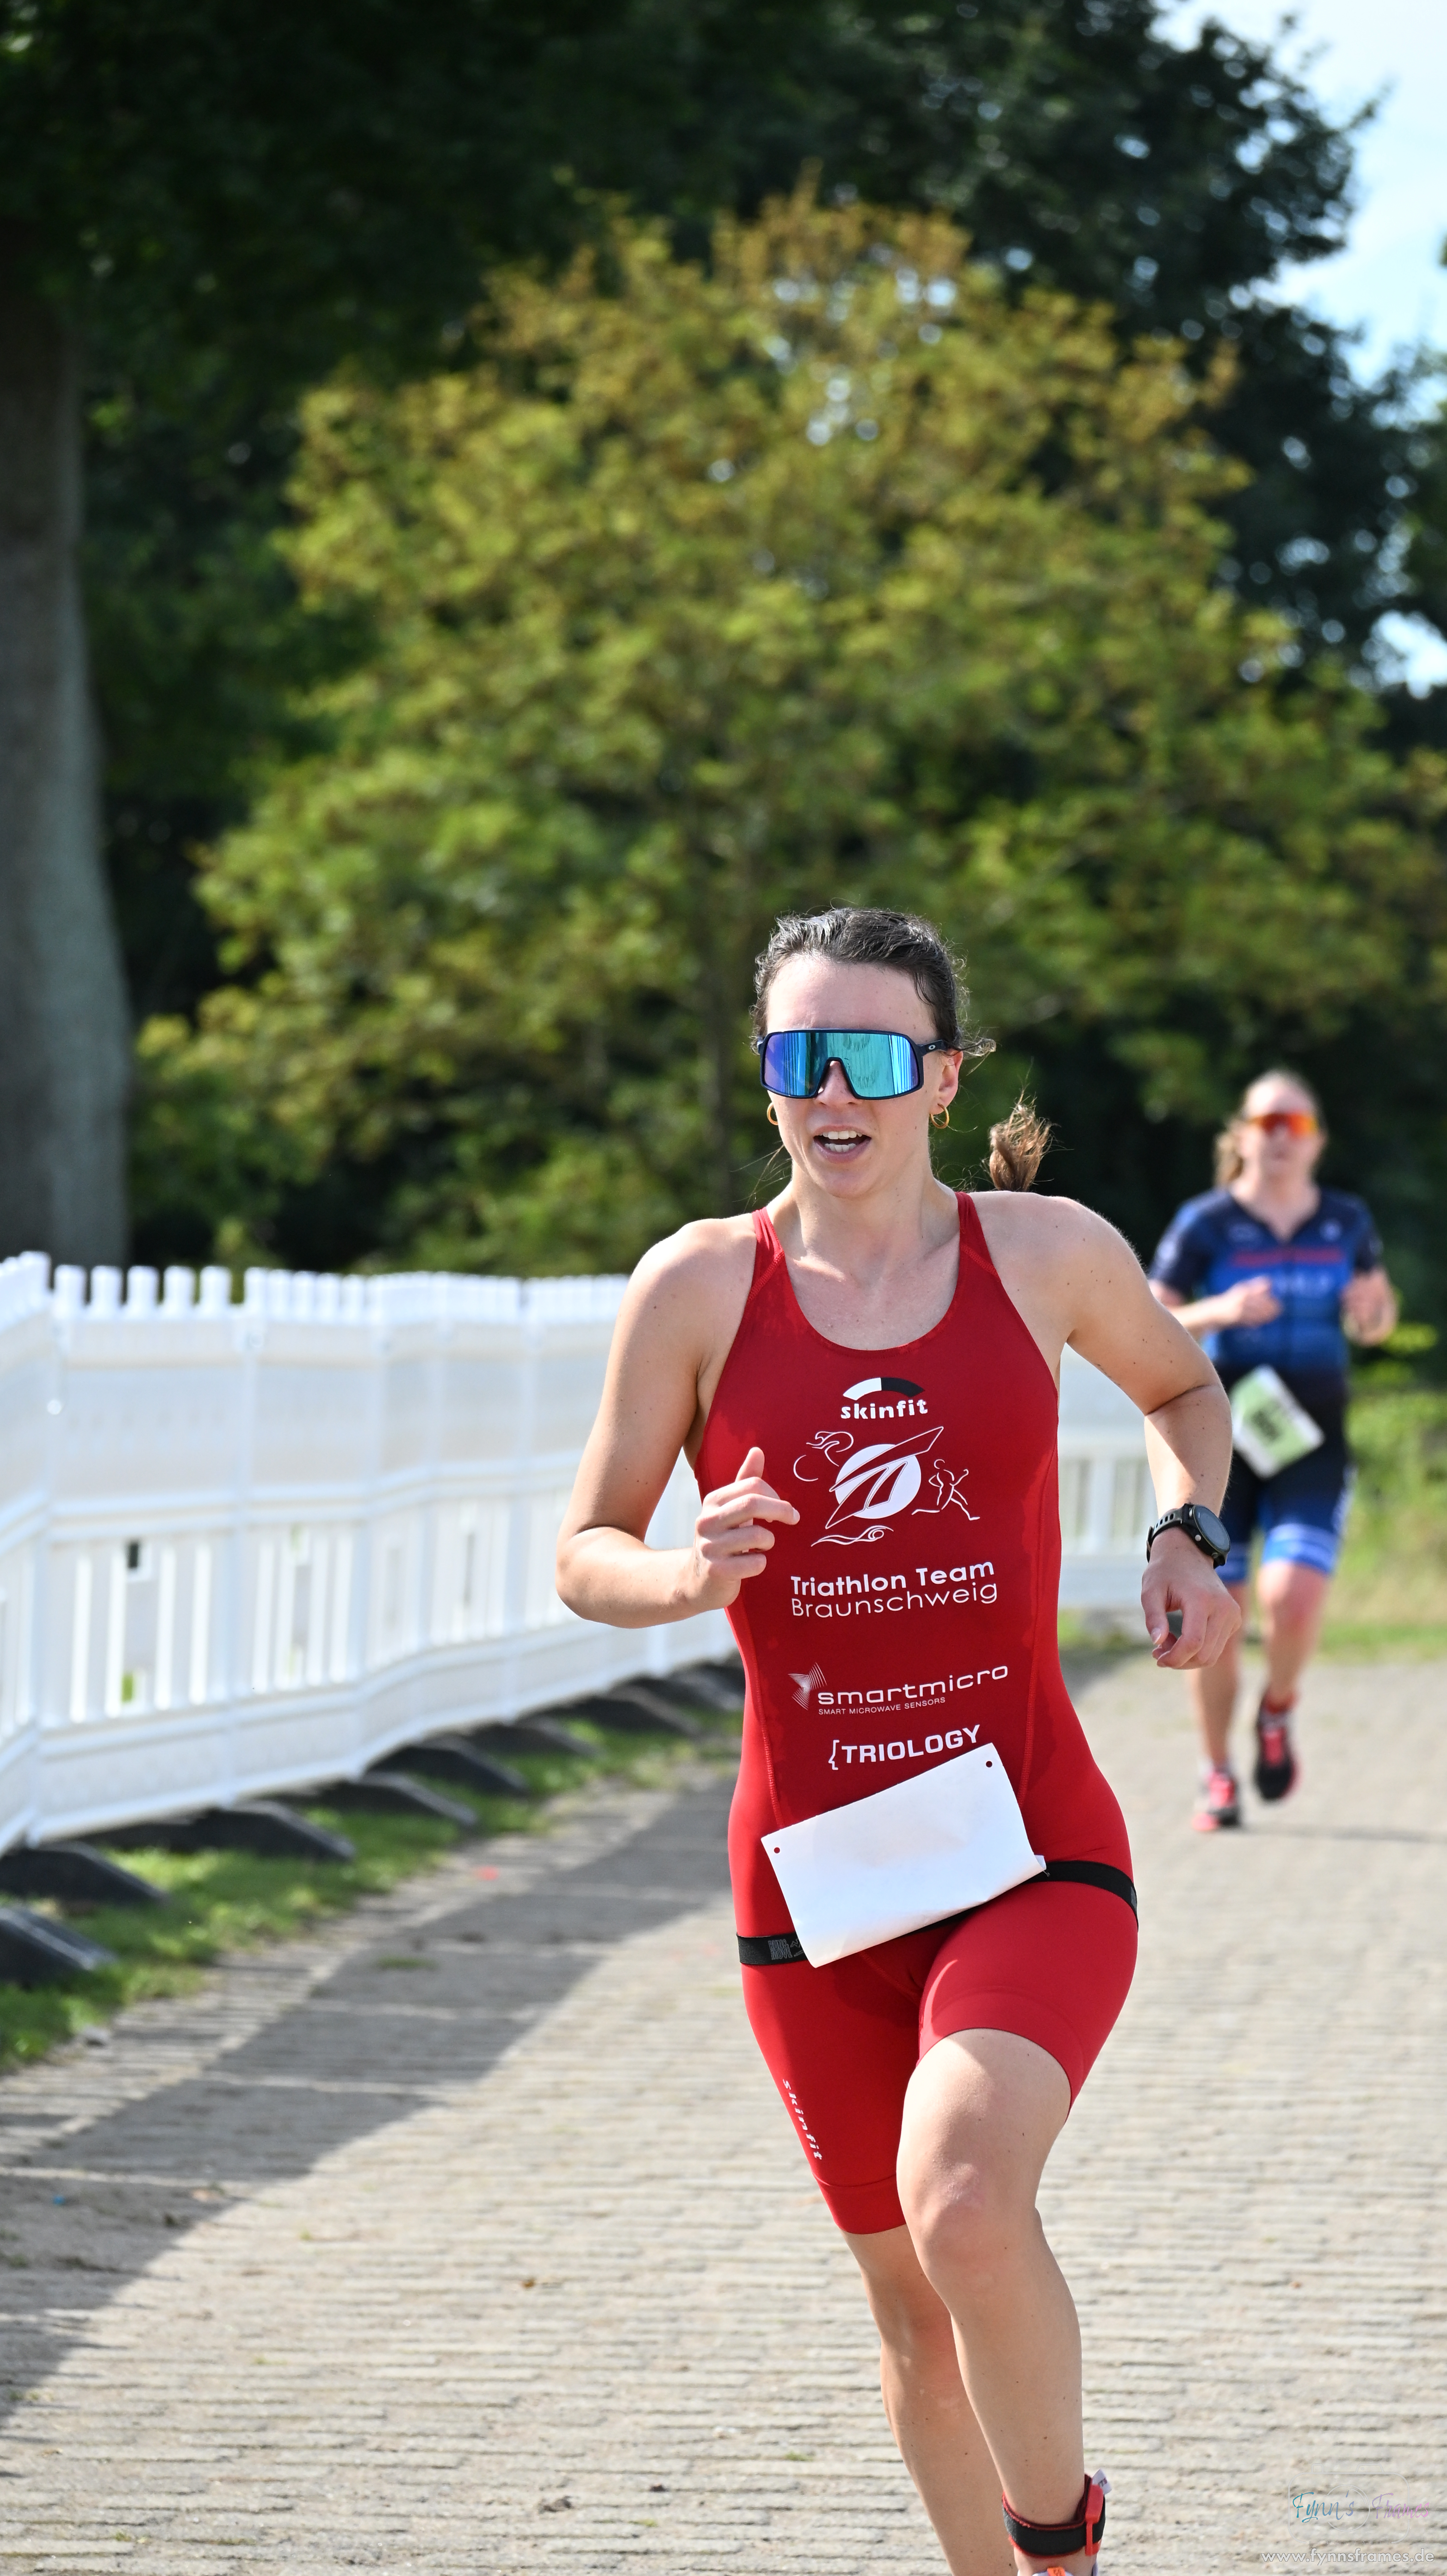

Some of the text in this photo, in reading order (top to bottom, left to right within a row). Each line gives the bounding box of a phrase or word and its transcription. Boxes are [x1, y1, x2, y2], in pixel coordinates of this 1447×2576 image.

[841, 1399, 928, 1419] skinfit
[791, 1561, 994, 1597] Triathlon Team
[792, 1582, 997, 1618] Braunschweig
[818, 1666, 1008, 1705] smartmicro
[849, 1704, 901, 1714] MICROWAVE
[904, 1697, 946, 1709] SENSORS
[782, 2079, 822, 2160] skinfit
